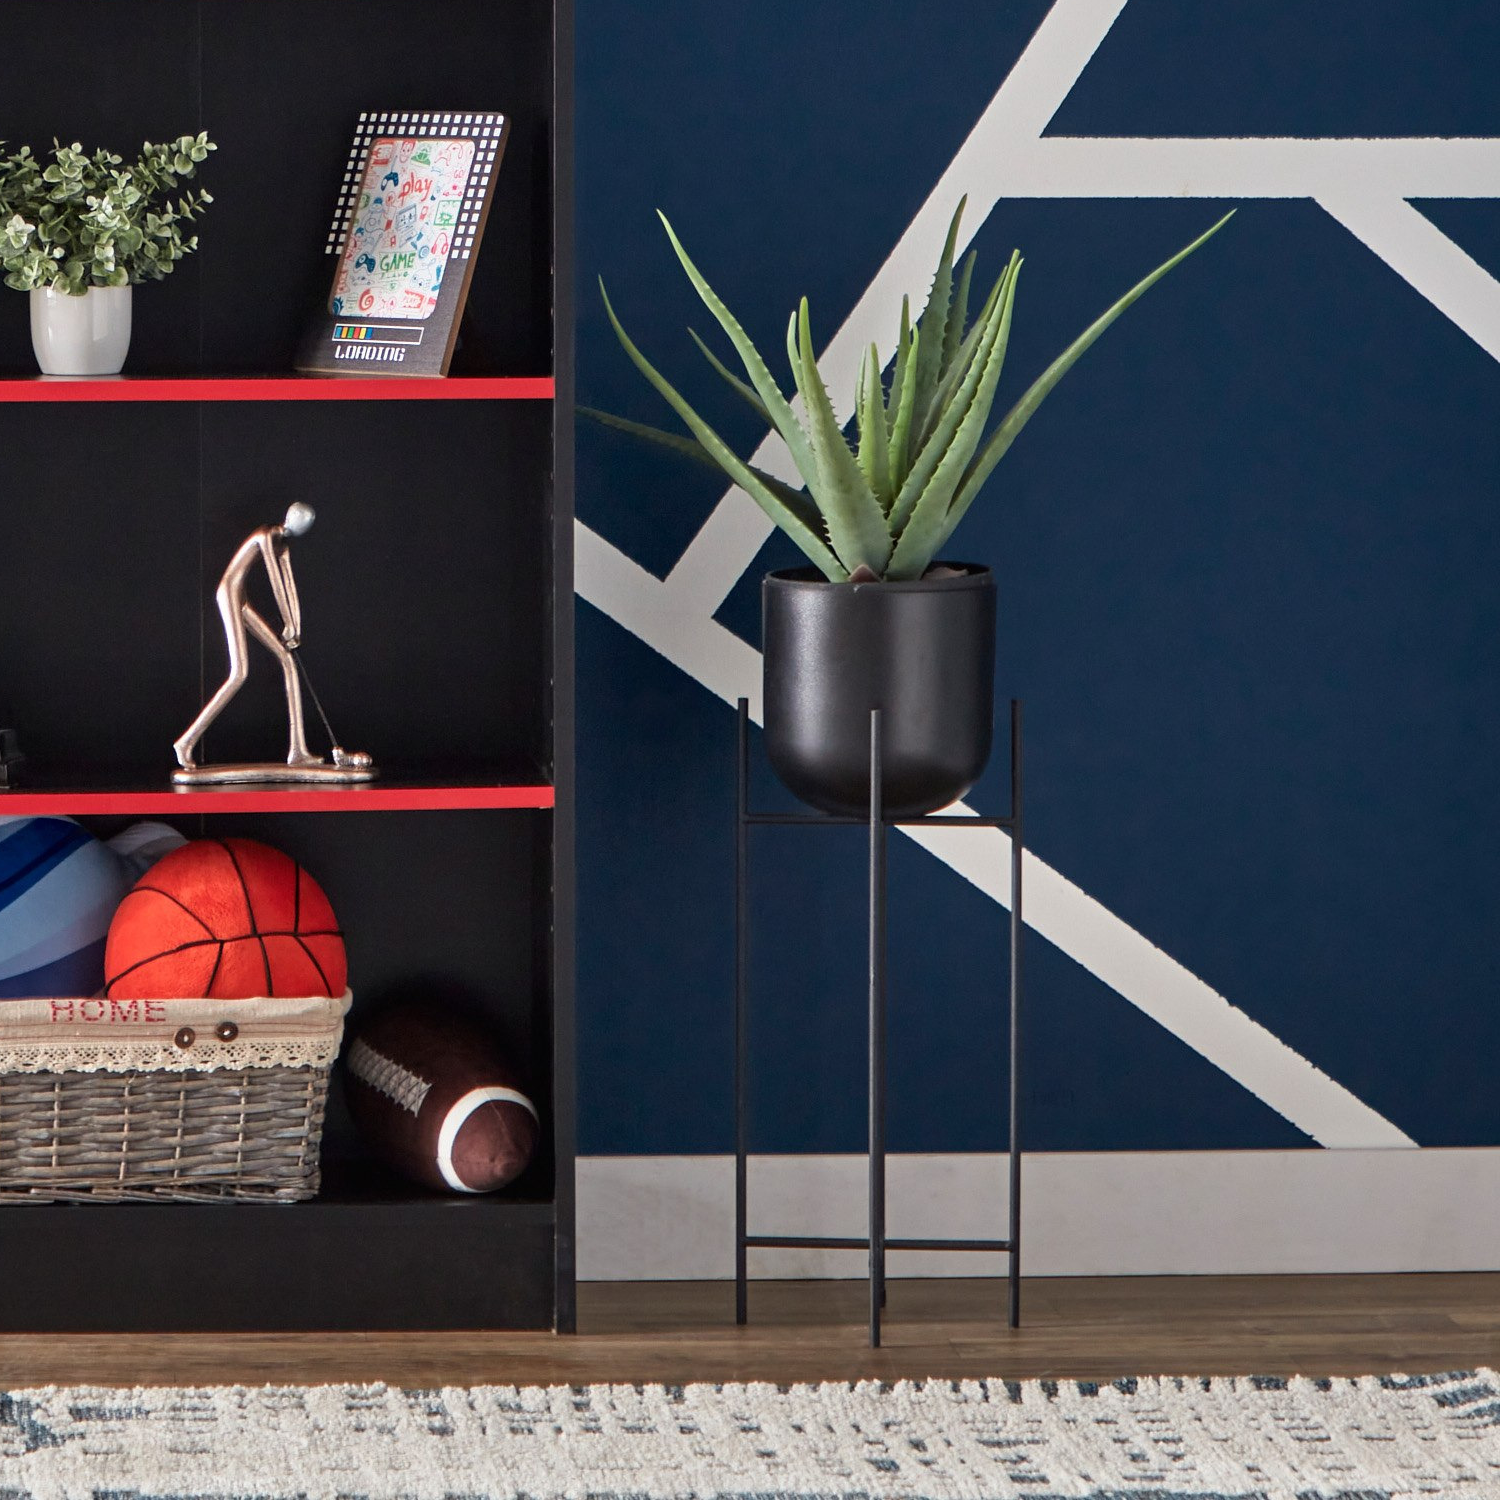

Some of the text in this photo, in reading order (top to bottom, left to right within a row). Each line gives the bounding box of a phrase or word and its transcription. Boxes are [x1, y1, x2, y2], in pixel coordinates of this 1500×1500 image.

[398, 172, 433, 206] play
[380, 252, 417, 272] GAME
[334, 345, 406, 362] LOADING
[50, 999, 167, 1023] HOME
